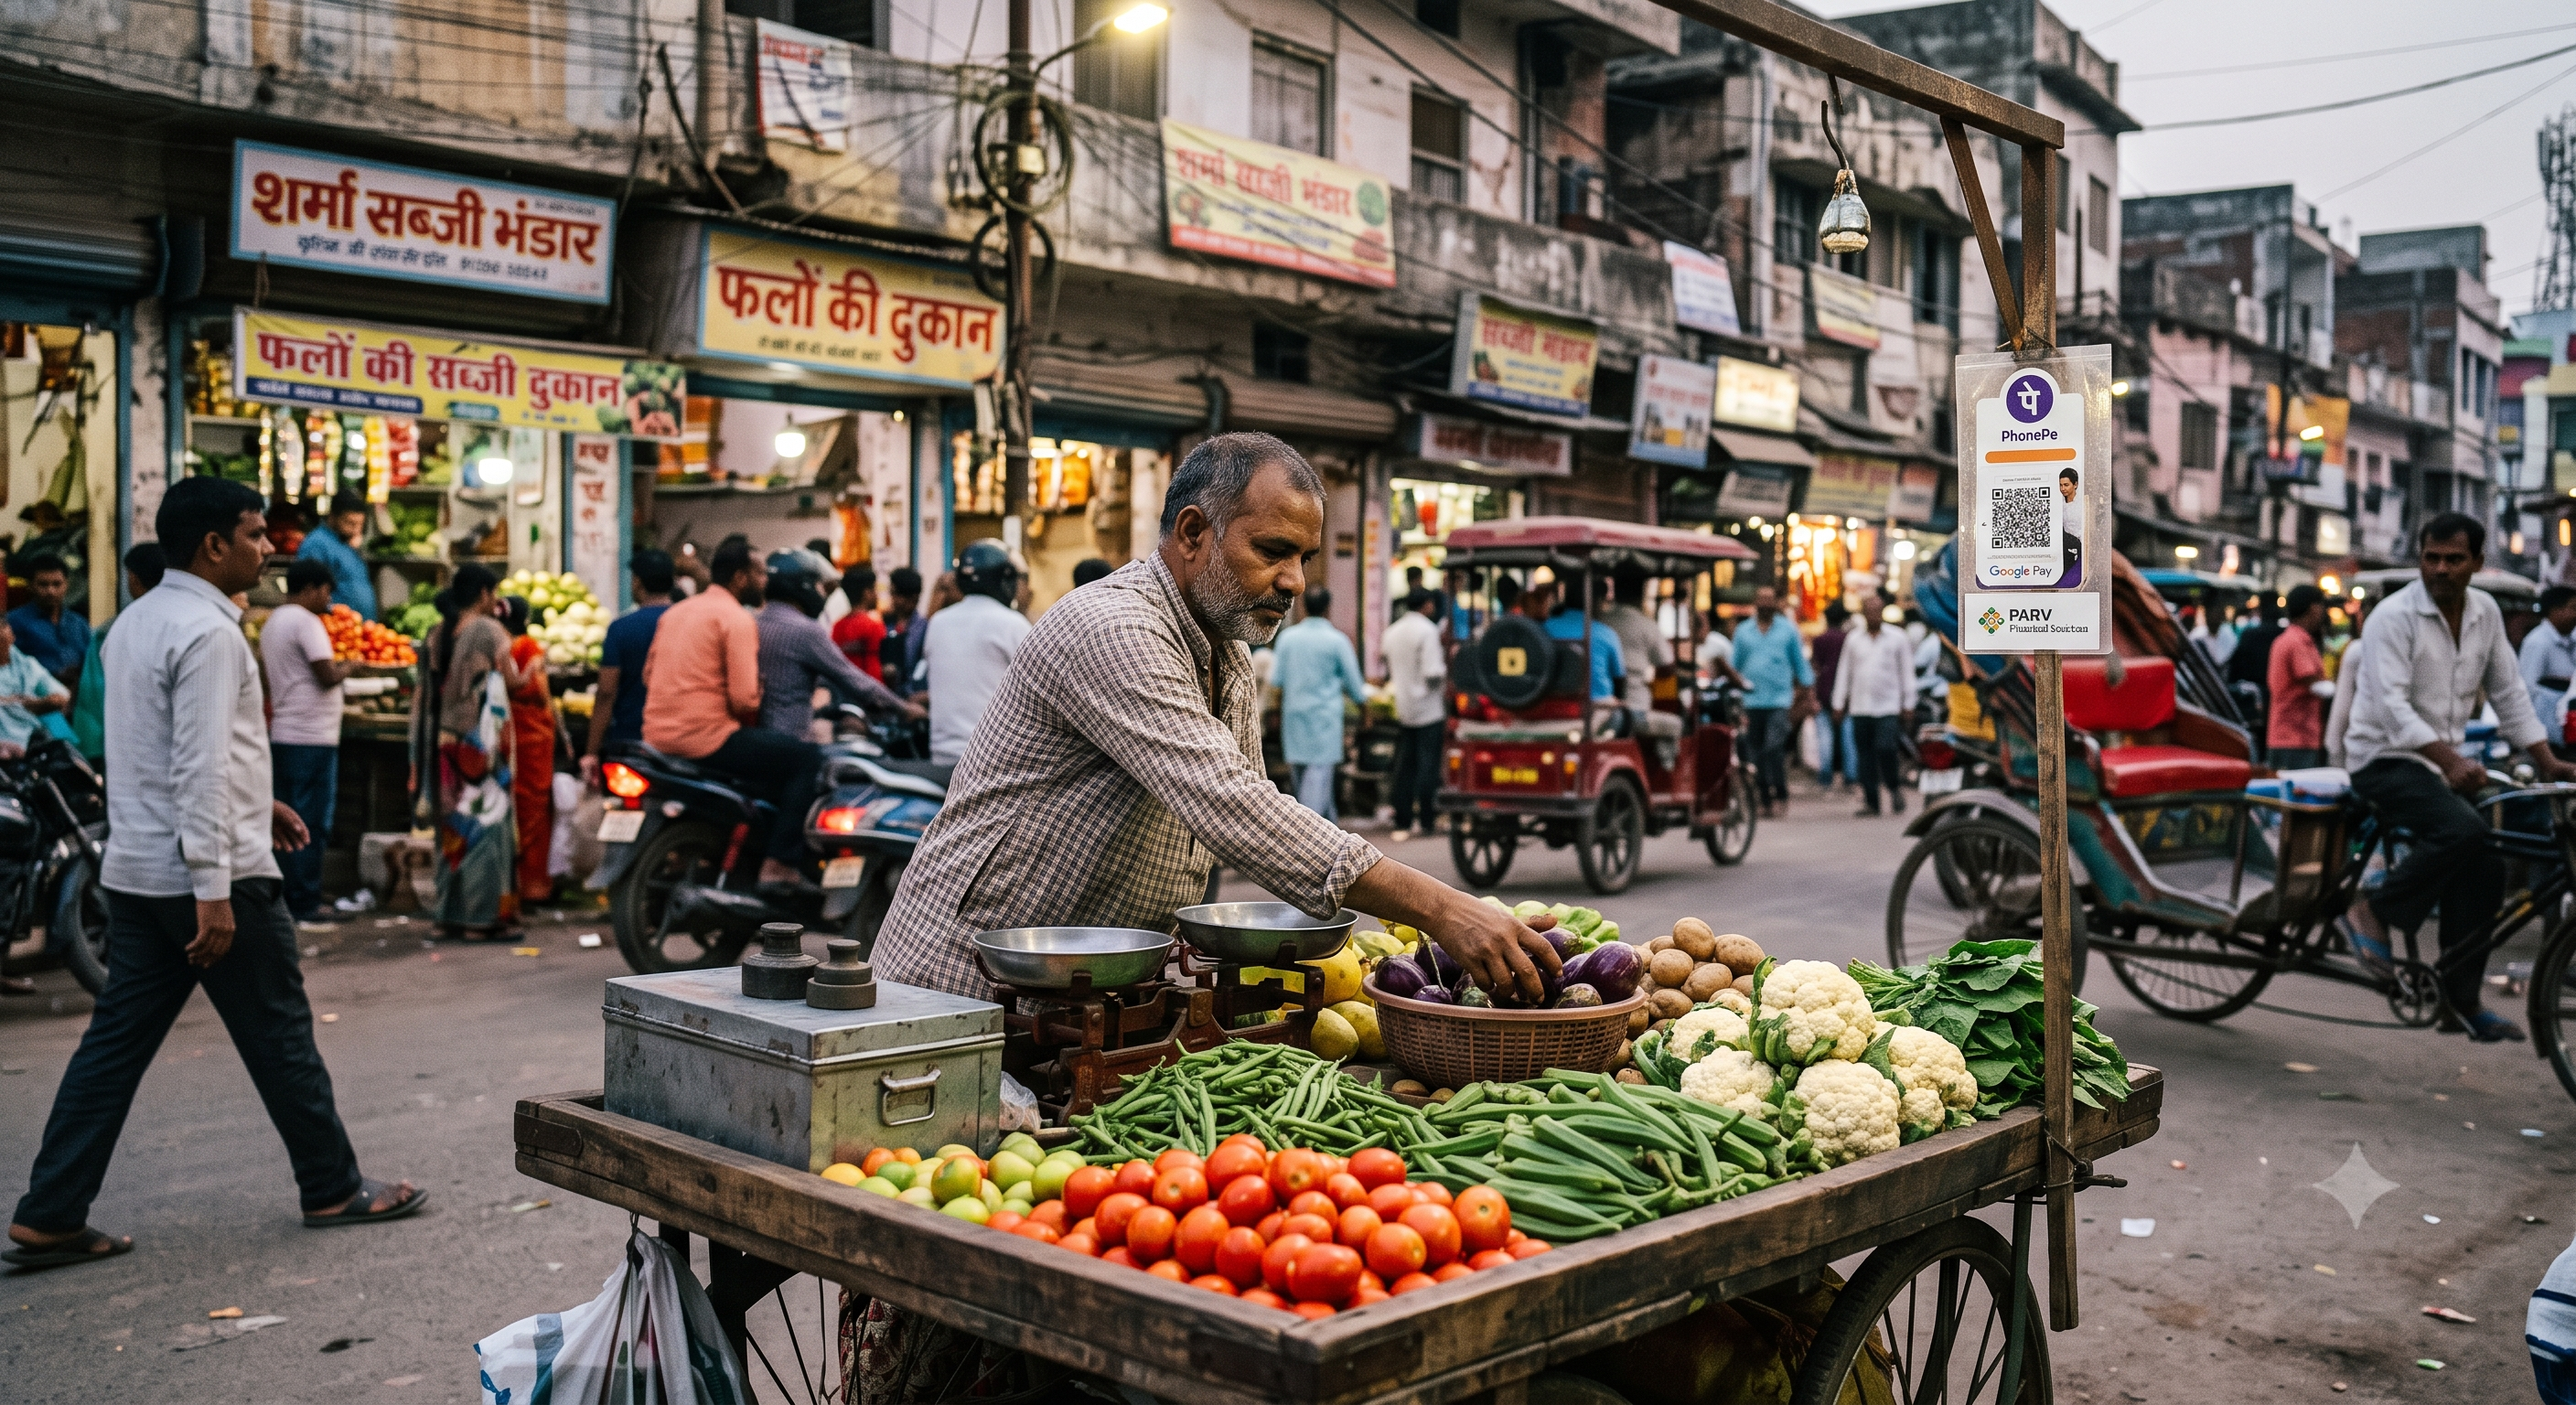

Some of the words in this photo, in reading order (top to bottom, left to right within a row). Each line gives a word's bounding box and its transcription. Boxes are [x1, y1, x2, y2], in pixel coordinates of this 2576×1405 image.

[252, 169, 360, 231] शर्मा
[366, 188, 487, 249] सब्जी
[494, 200, 602, 265] भंडार
[715, 258, 820, 329] फलों
[829, 267, 881, 337] की
[891, 292, 998, 363] दुकान
[257, 332, 355, 380] फलों
[362, 340, 415, 387] की
[426, 353, 517, 398] सब्जी
[527, 367, 621, 413] दुकान
[2002, 427, 2058, 443] PhonePe
[1989, 564, 2030, 579] Google
[2033, 565, 2052, 578] Pay
[2009, 608, 2053, 622] PARV
